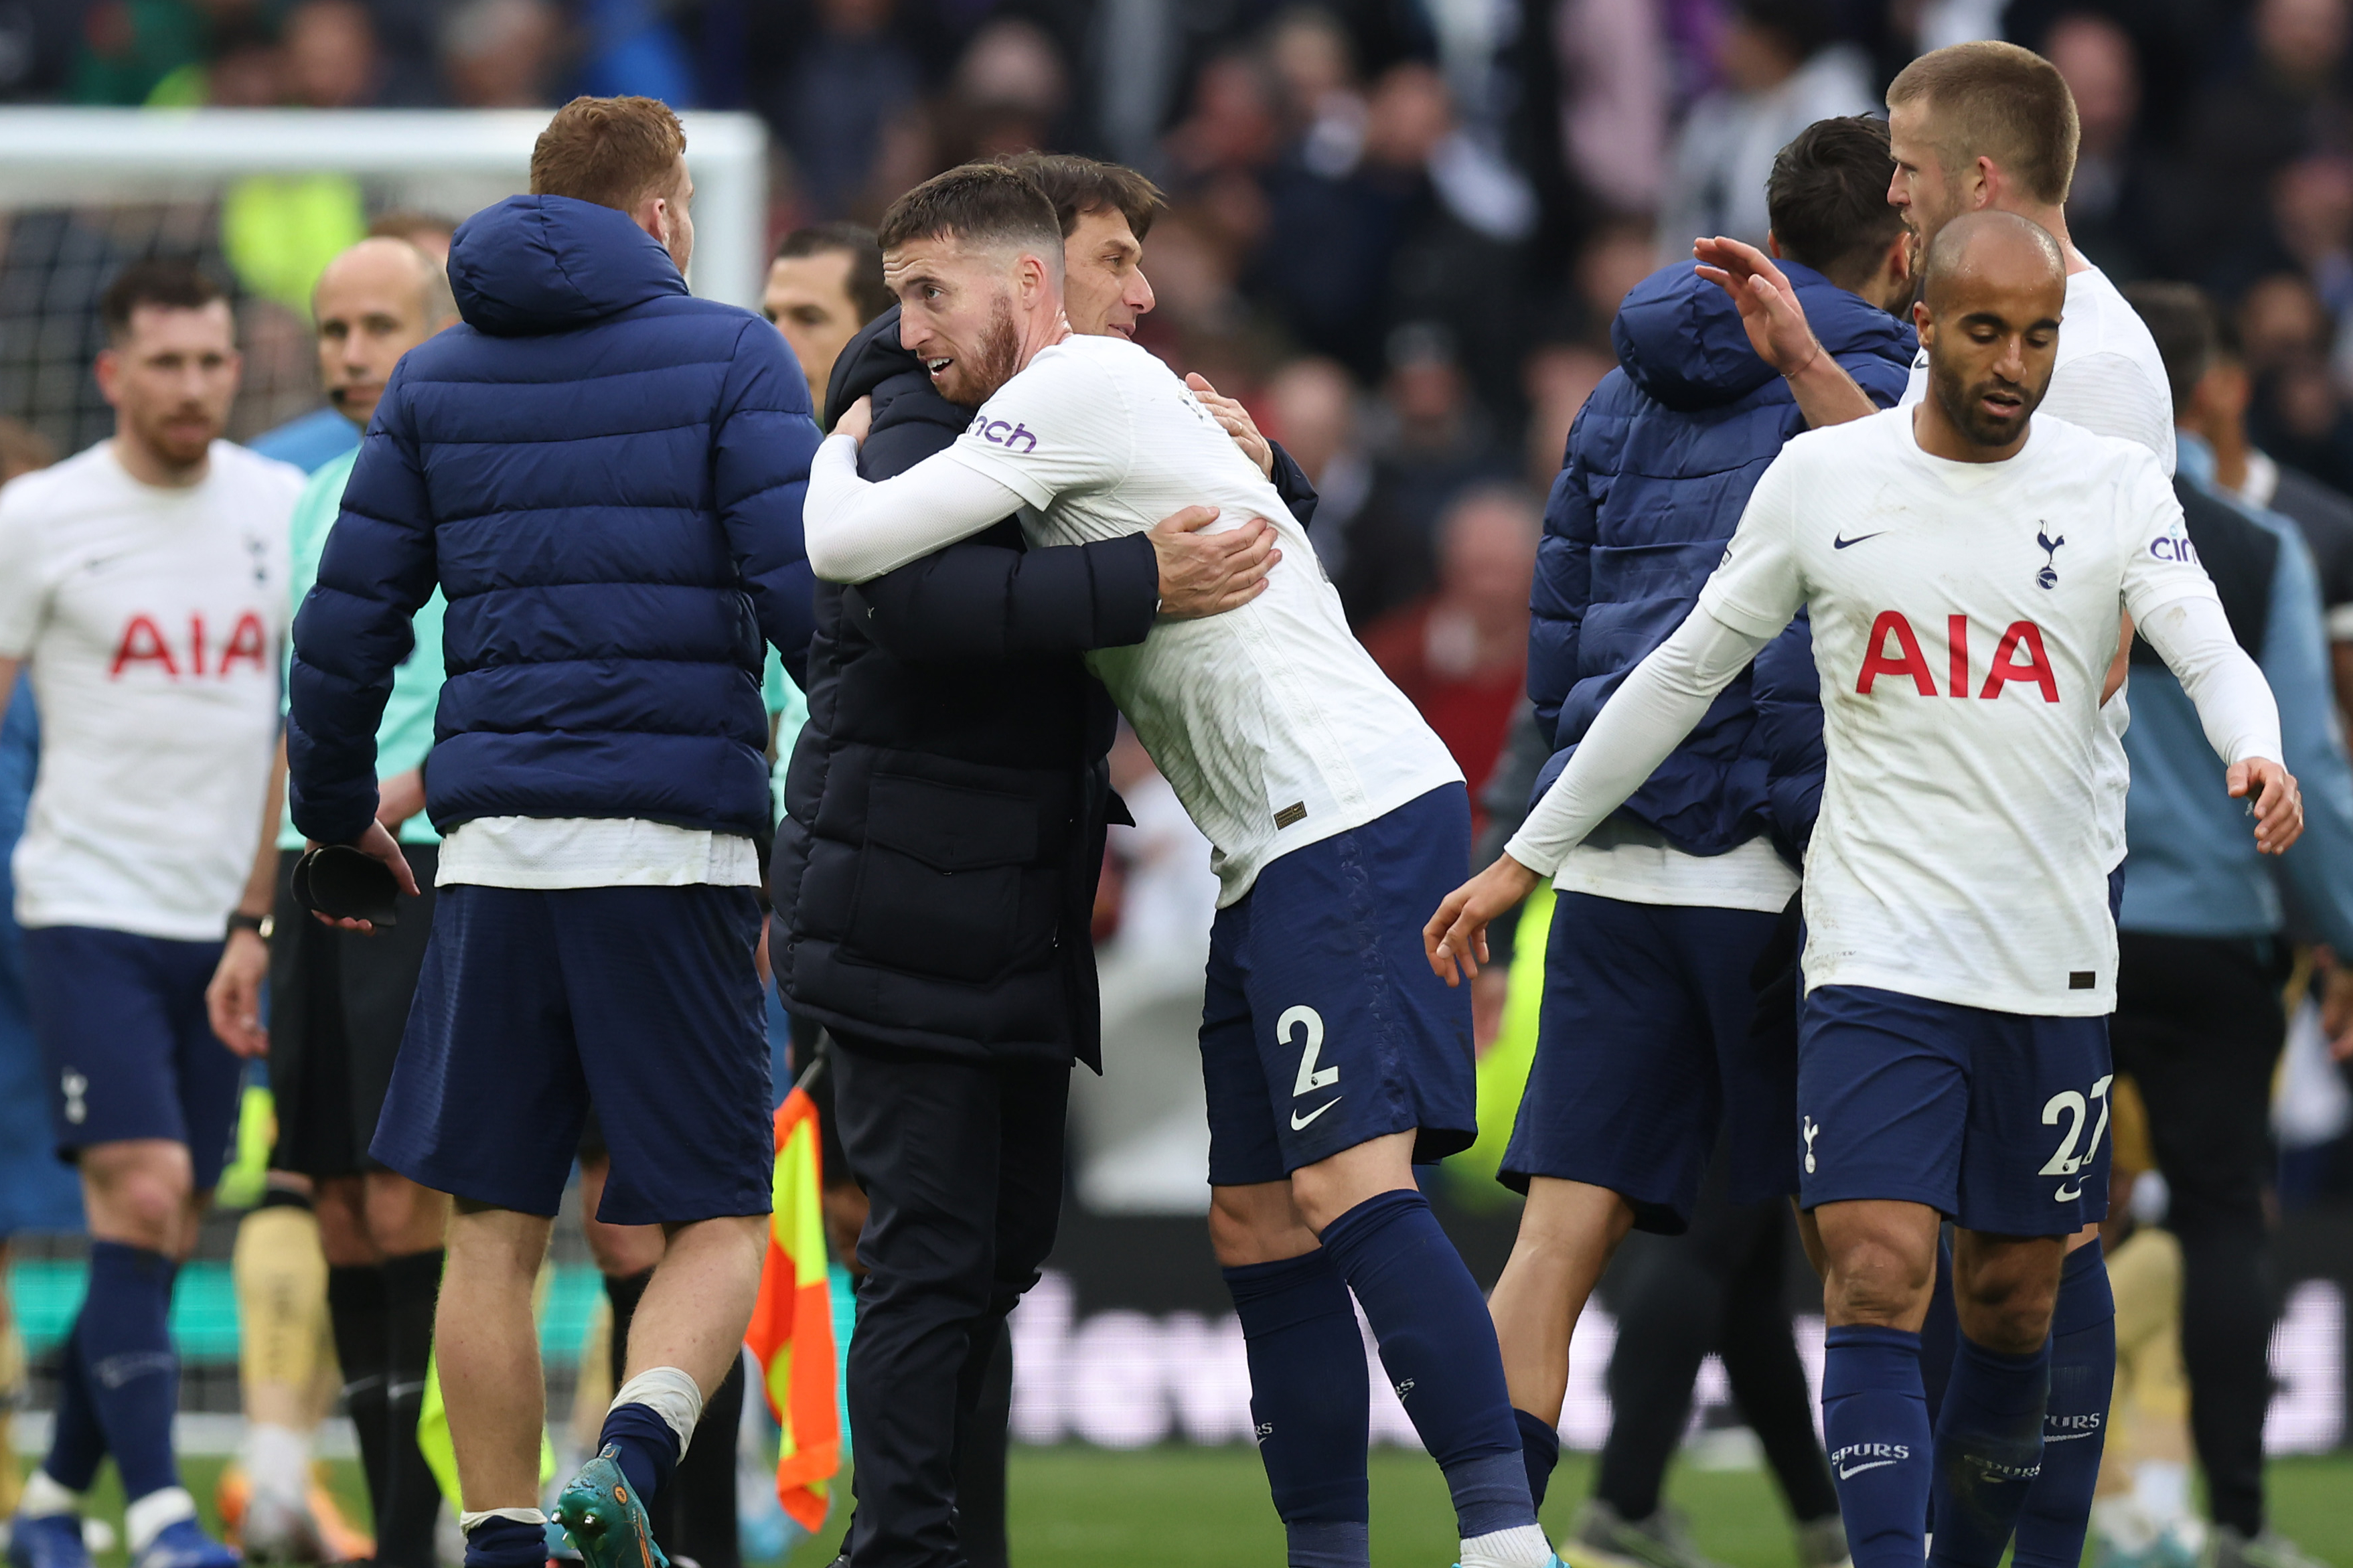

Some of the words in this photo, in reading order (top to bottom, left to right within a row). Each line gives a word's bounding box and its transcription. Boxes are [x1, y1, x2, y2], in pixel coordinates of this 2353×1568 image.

[110, 610, 266, 680] AIA
[1855, 610, 2060, 703] AIA
[1276, 1005, 1339, 1097] 2
[2038, 1074, 2113, 1175] 27
[1831, 1443, 1909, 1466] SPURS
[2044, 1413, 2100, 1429] URS
